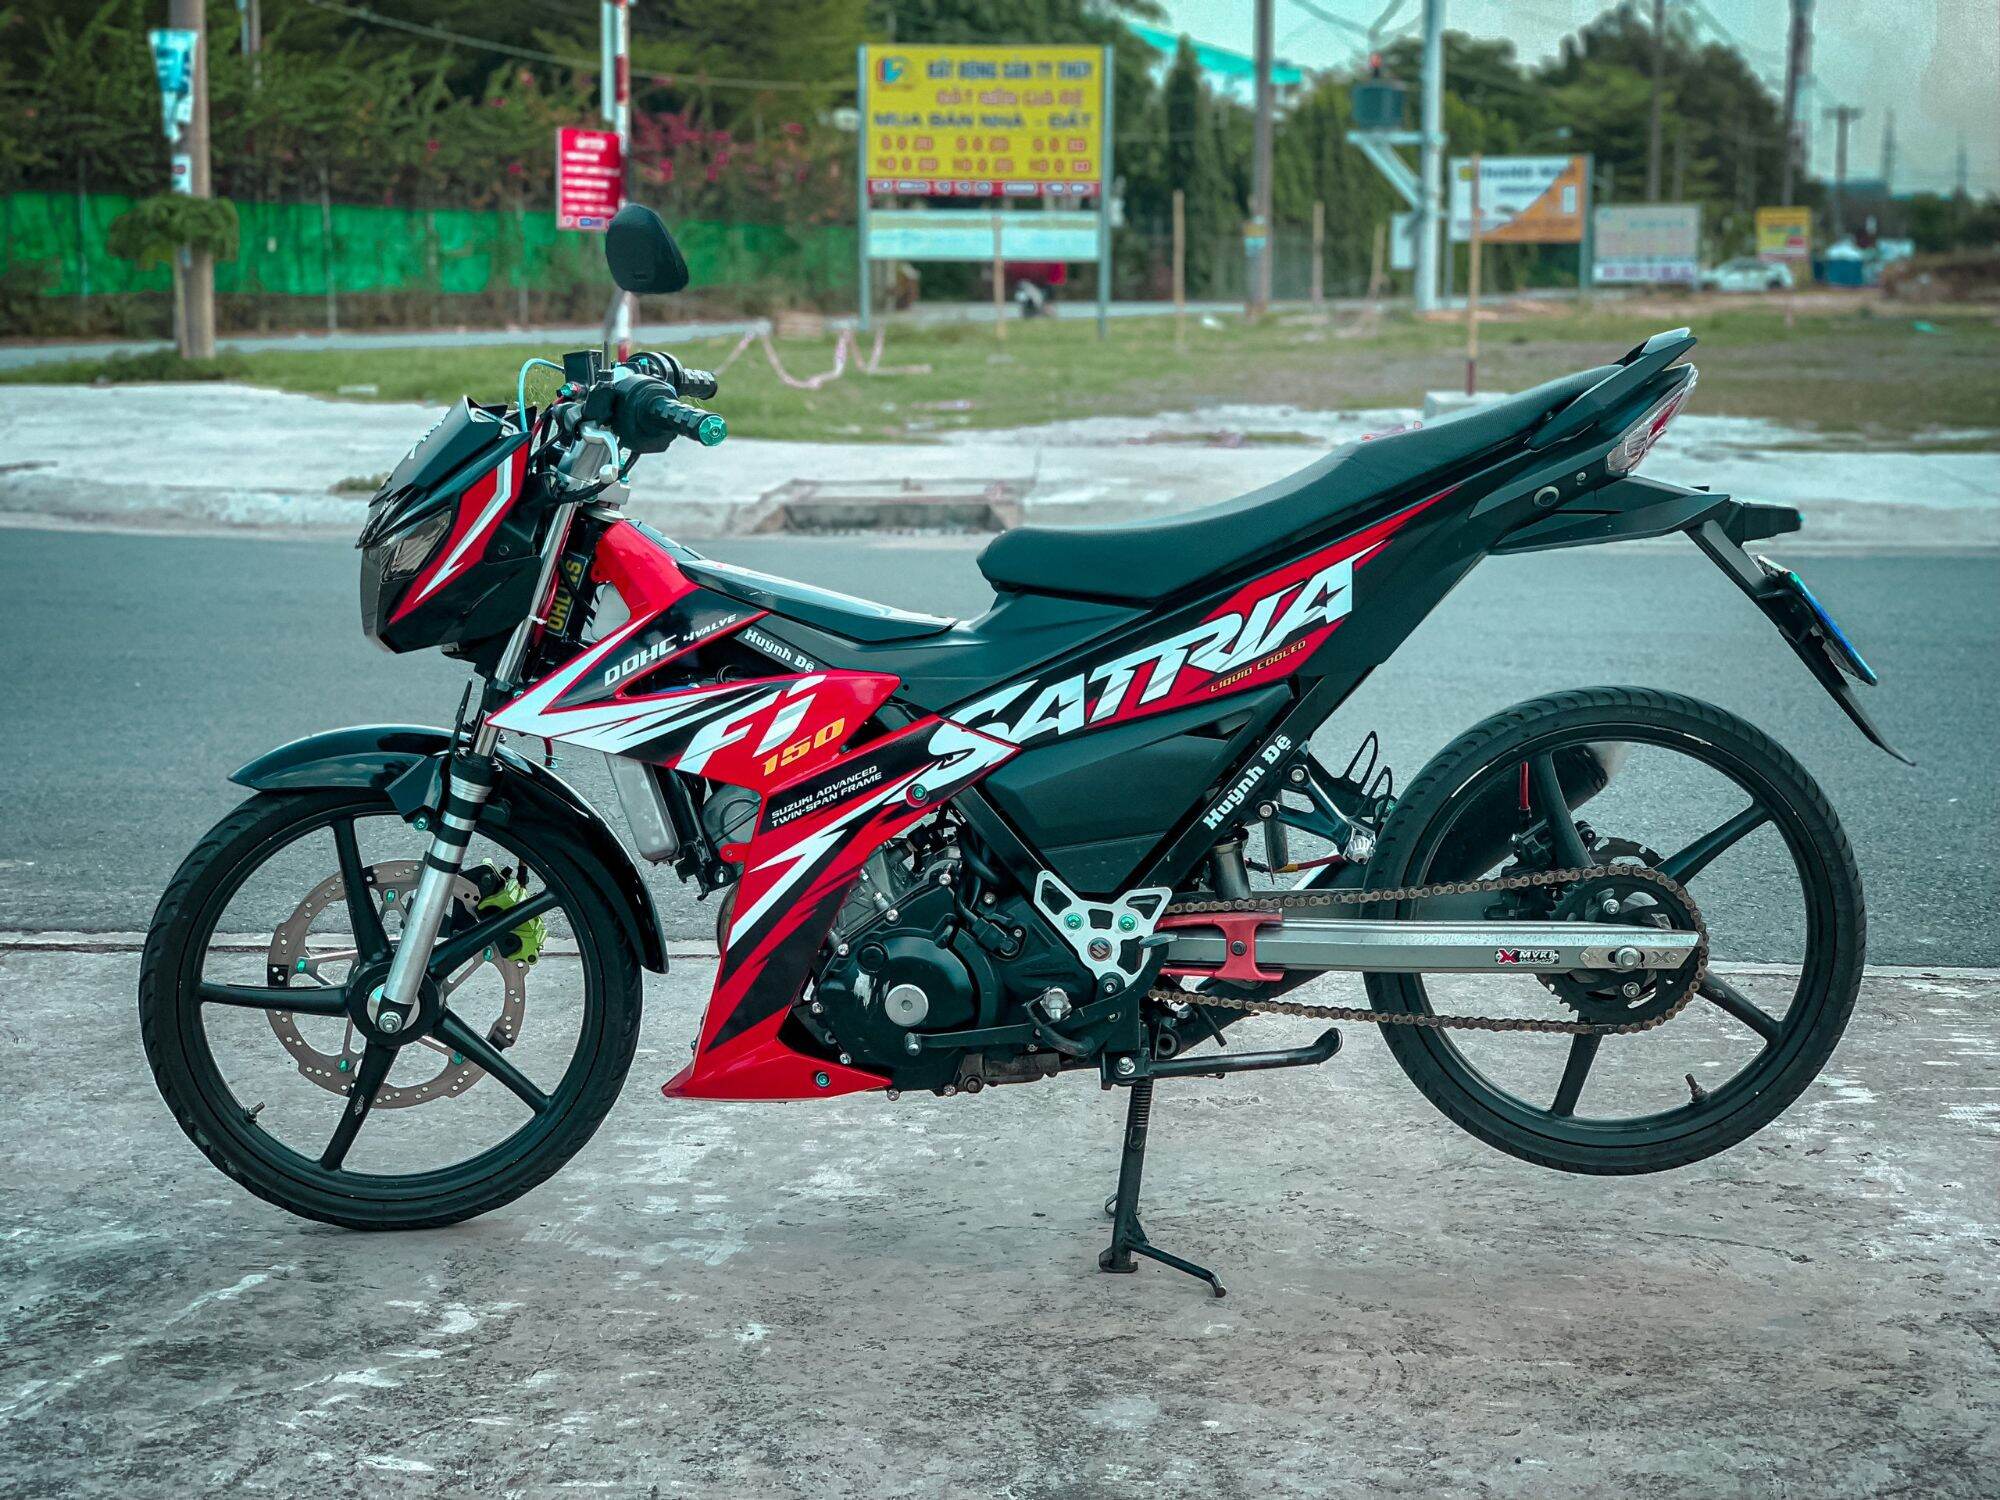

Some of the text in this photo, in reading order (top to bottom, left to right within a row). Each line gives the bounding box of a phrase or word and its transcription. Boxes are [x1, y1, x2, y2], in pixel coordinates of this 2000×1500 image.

[604, 613, 737, 687] DOHC 4VALVE
[910, 540, 1385, 792] SATRIA
[1210, 640, 1306, 693] LIQUID COOLED
[762, 717, 846, 777] 150
[771, 765, 878, 819] SUZUKI ADVANCED
[771, 771, 882, 827] TWIN-SPAN FRAME
